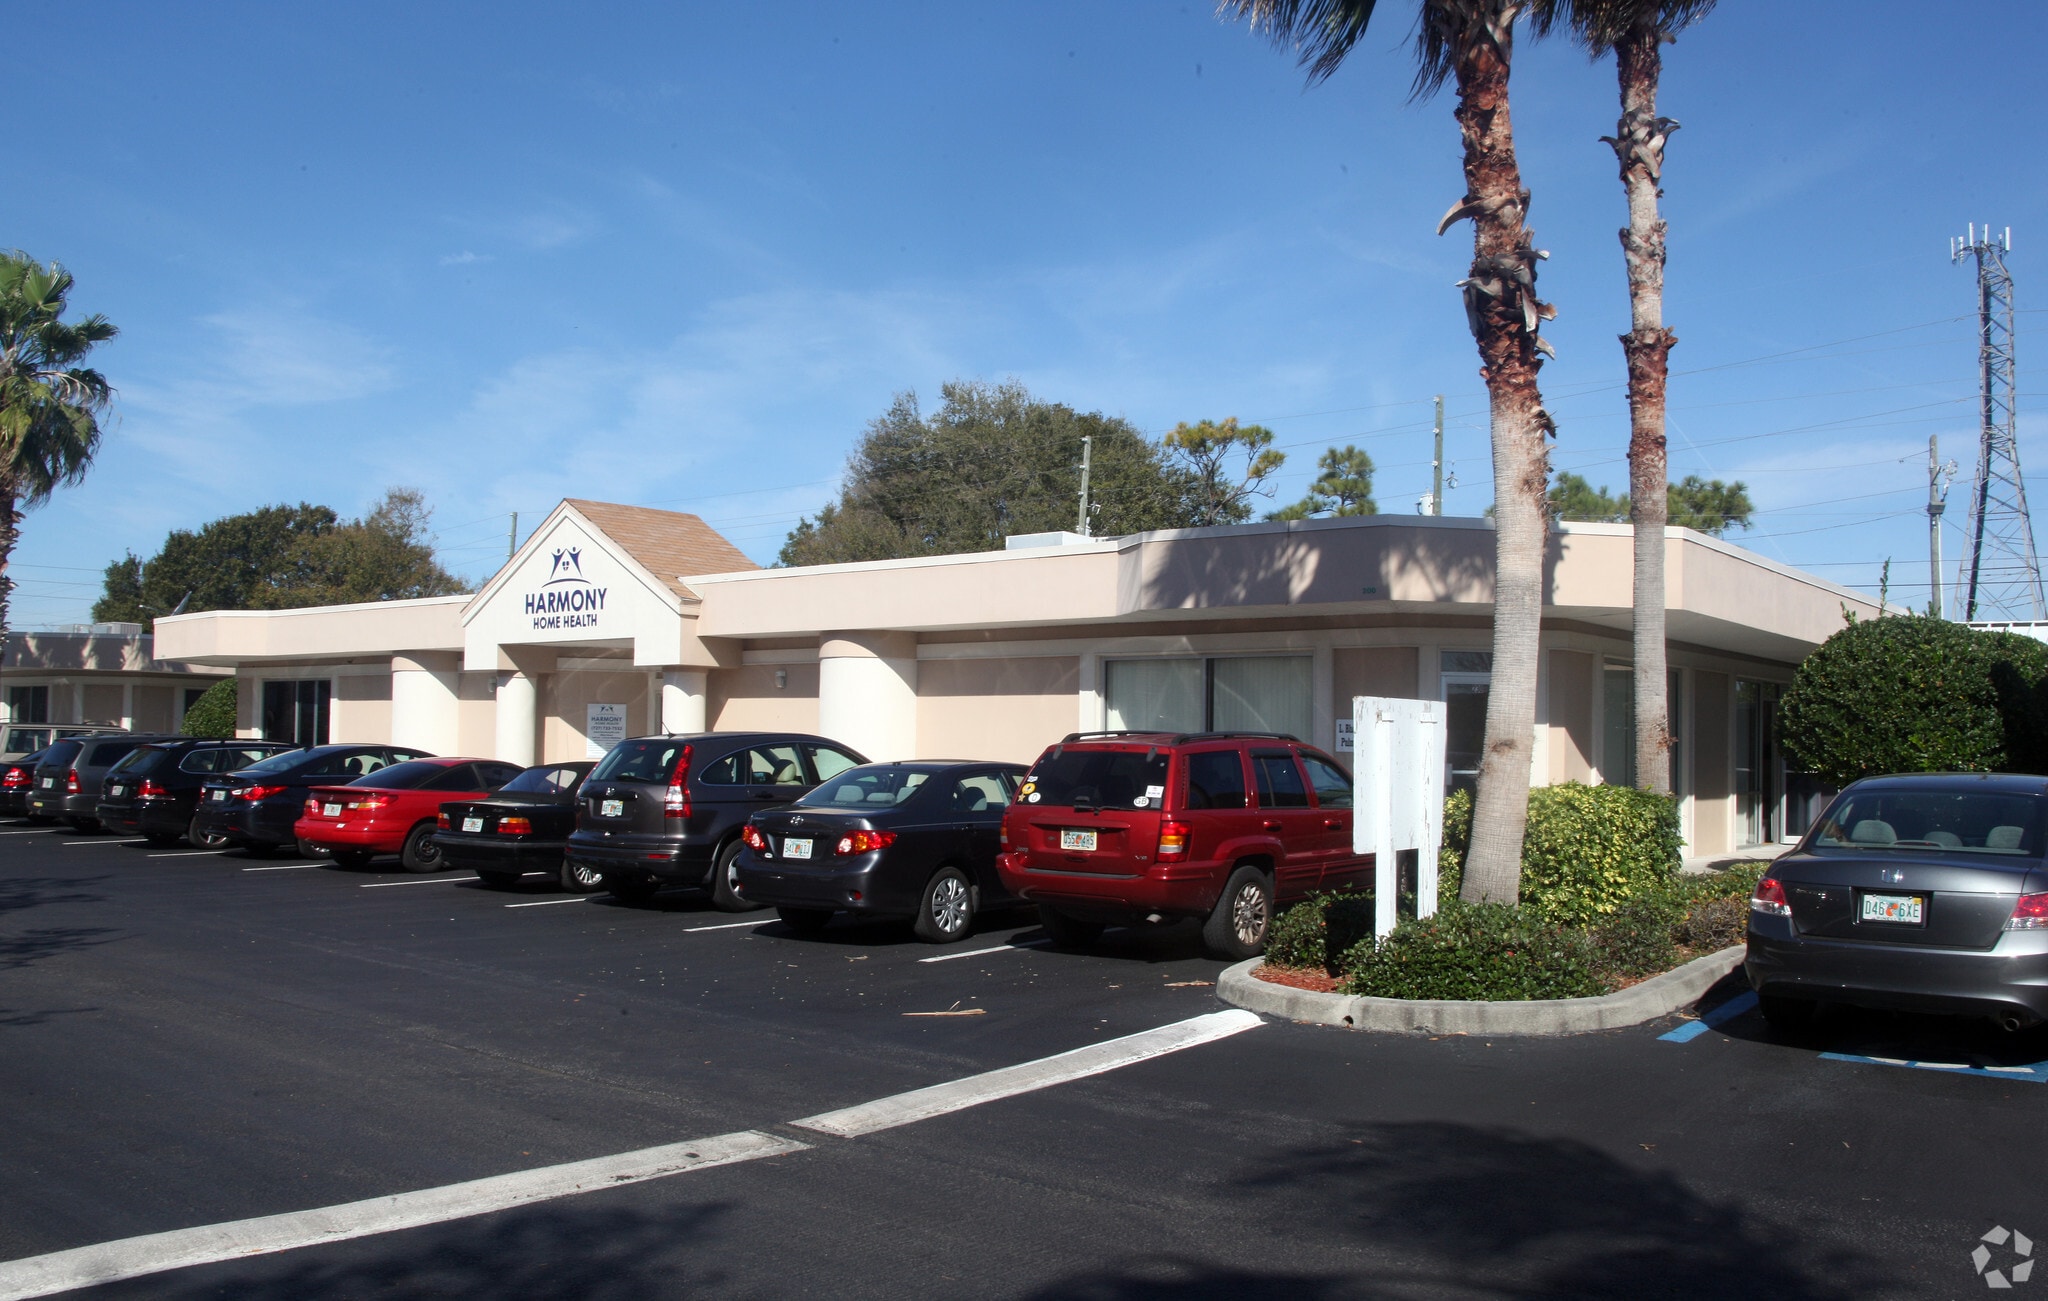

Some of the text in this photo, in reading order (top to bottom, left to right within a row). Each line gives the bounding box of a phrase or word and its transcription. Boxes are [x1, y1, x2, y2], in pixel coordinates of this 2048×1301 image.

[525, 588, 608, 615] HARMONY
[533, 614, 597, 630] HOME HEALTH
[1865, 900, 1920, 918] D46 6XE
